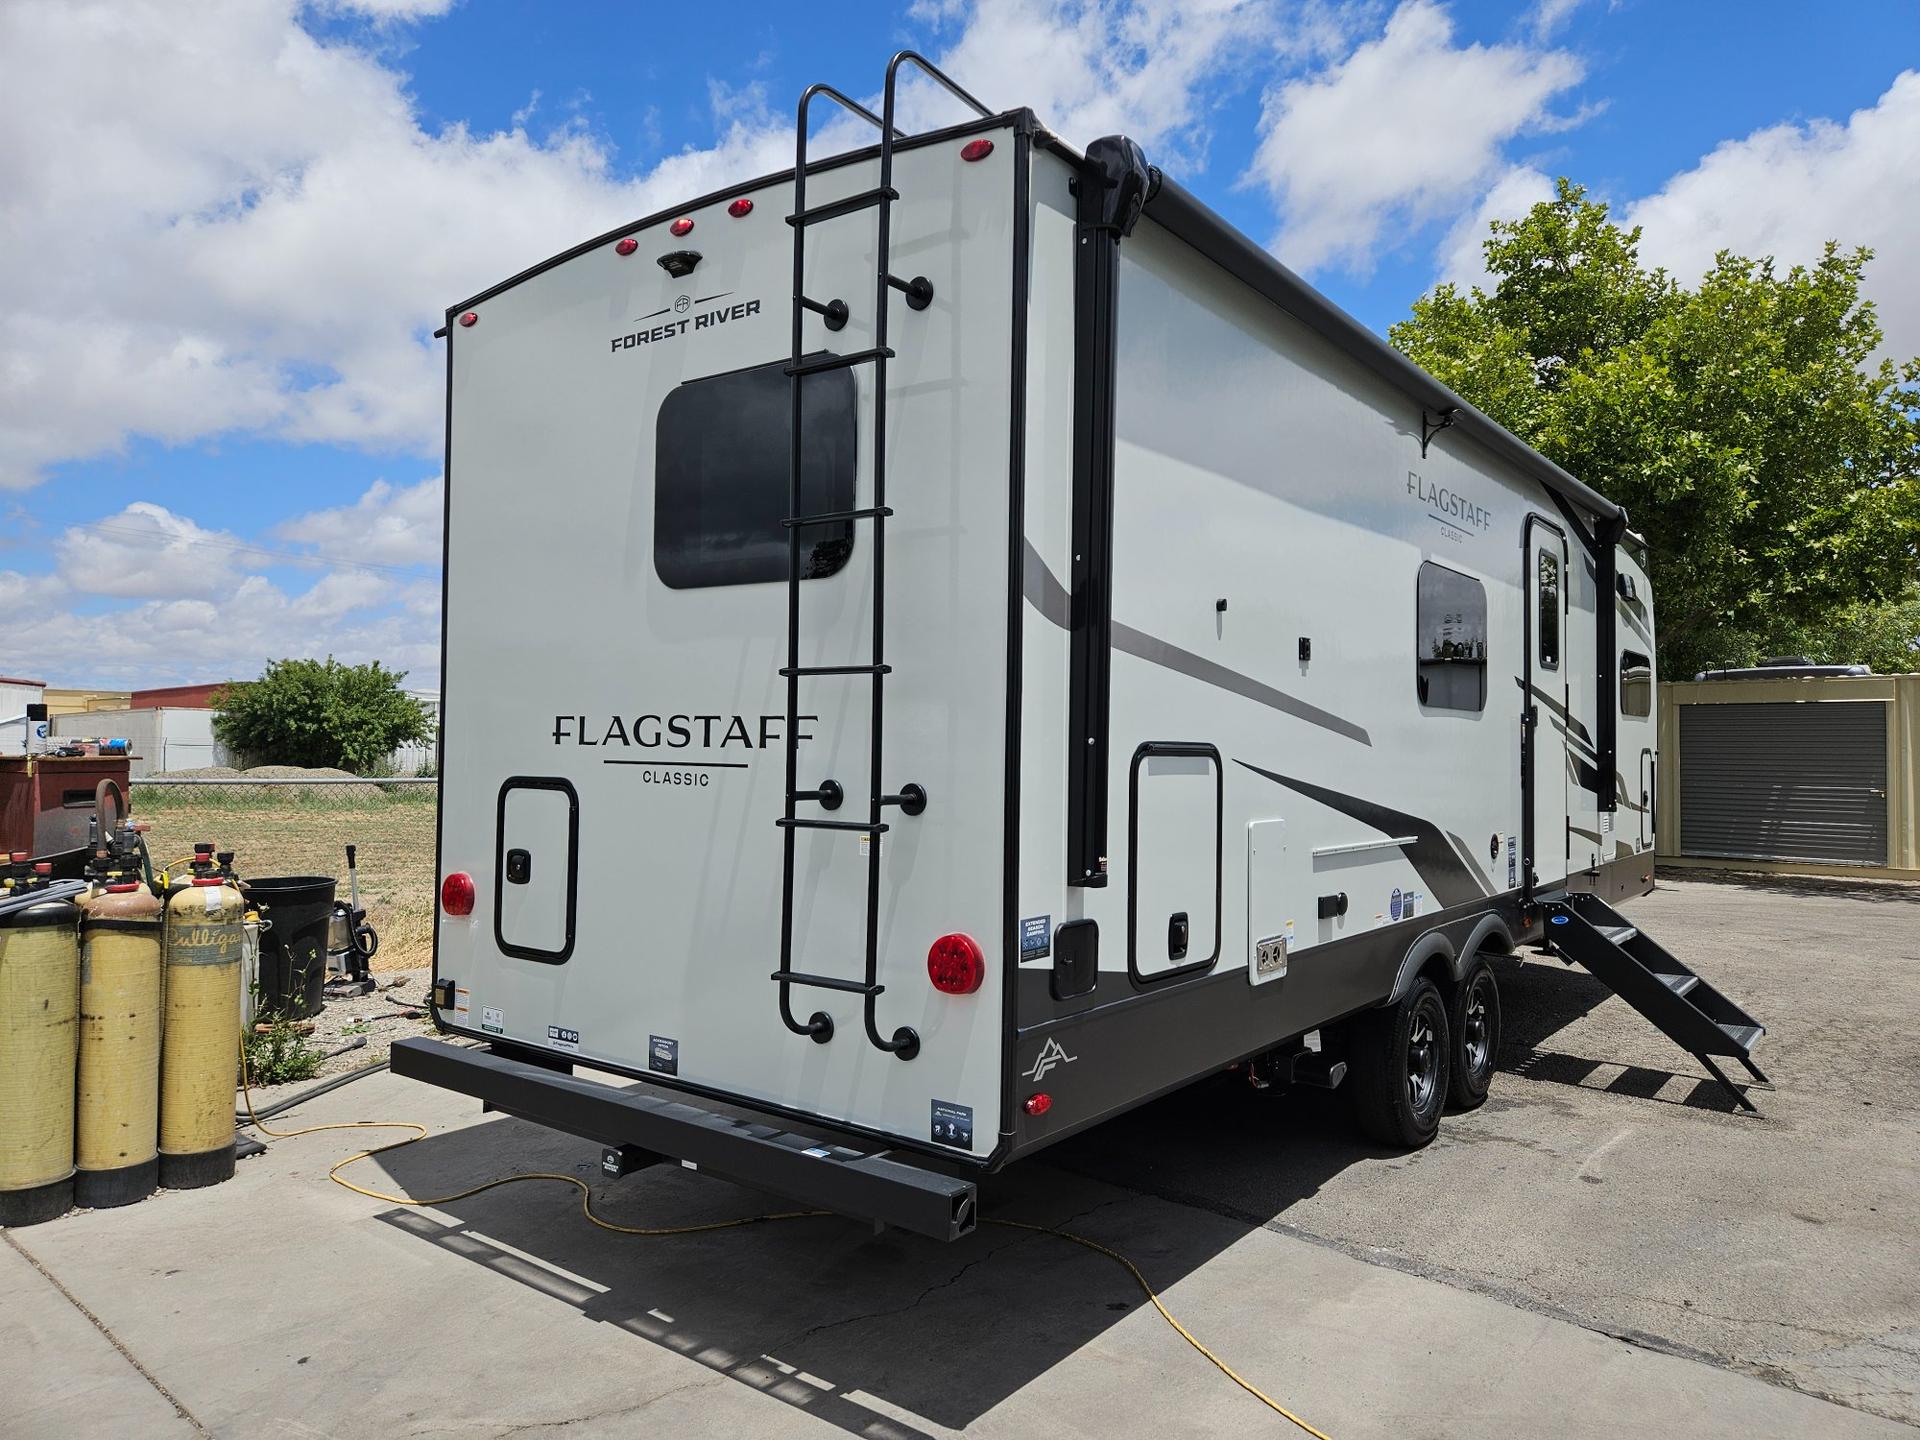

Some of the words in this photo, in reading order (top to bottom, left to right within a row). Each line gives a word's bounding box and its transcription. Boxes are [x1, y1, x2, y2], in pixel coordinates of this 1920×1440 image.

[610, 319, 690, 353] FOREST
[694, 299, 761, 330] RIVER
[1406, 470, 1491, 531] FLAGSTAFF
[552, 714, 819, 749] FLAGSTAFF
[642, 770, 709, 787] CLASSIC
[1025, 918, 1046, 927] EXTENDED
[1026, 929, 1045, 937] CAMPING
[1027, 924, 1045, 932] SEASON
[168, 927, 241, 954] Culliga
